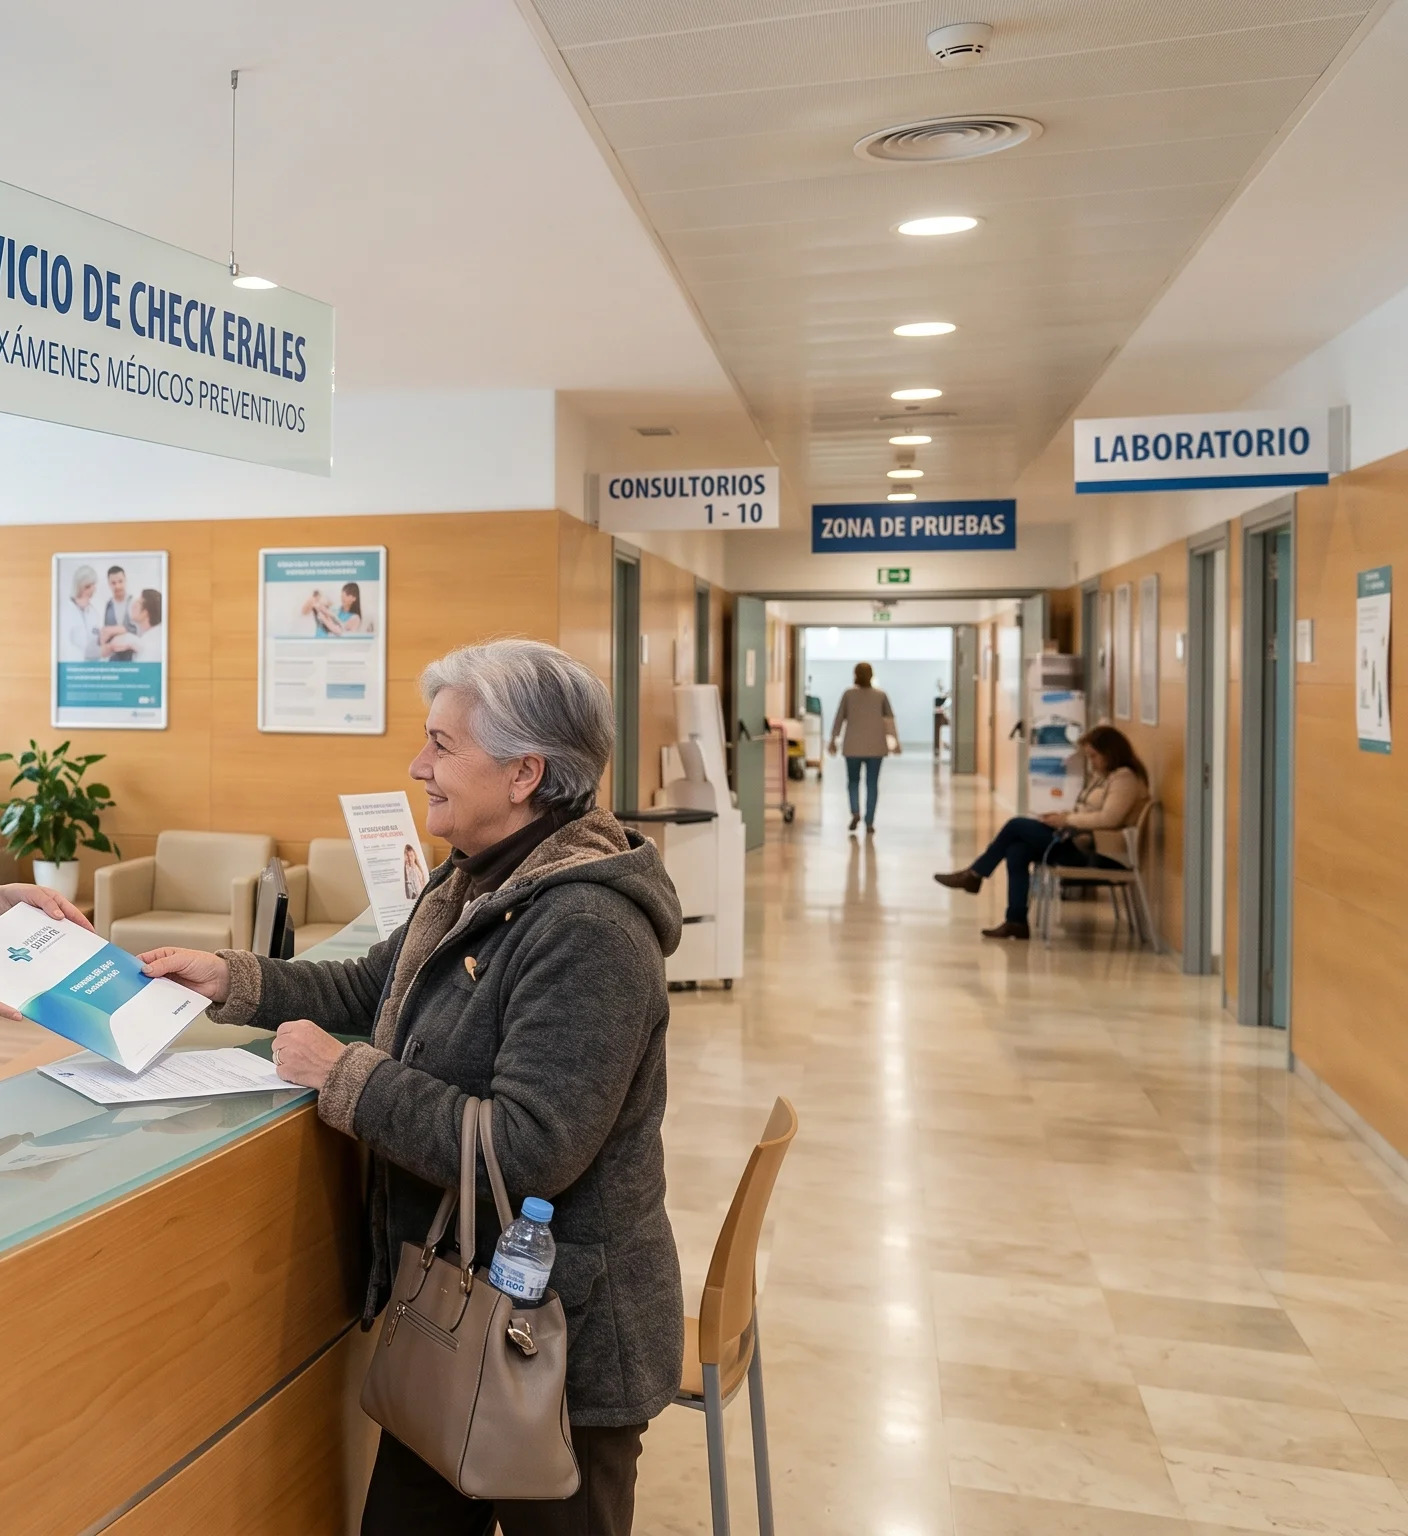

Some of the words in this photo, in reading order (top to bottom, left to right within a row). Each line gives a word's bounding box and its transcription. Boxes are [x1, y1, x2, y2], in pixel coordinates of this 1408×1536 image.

[83, 263, 121, 330] DE
[129, 281, 216, 358] CHECK
[222, 310, 307, 383] ERALES
[107, 354, 194, 407] MÉDICOS
[199, 380, 307, 433] PREVENTIVOS
[1093, 426, 1311, 463] LABORATORIO
[608, 474, 766, 500] CONSULTORIOS
[704, 503, 714, 524] 1
[736, 502, 763, 524] 10
[821, 517, 876, 539] ZONA
[880, 516, 906, 538] DE
[910, 514, 1006, 537] PRUEBAS
